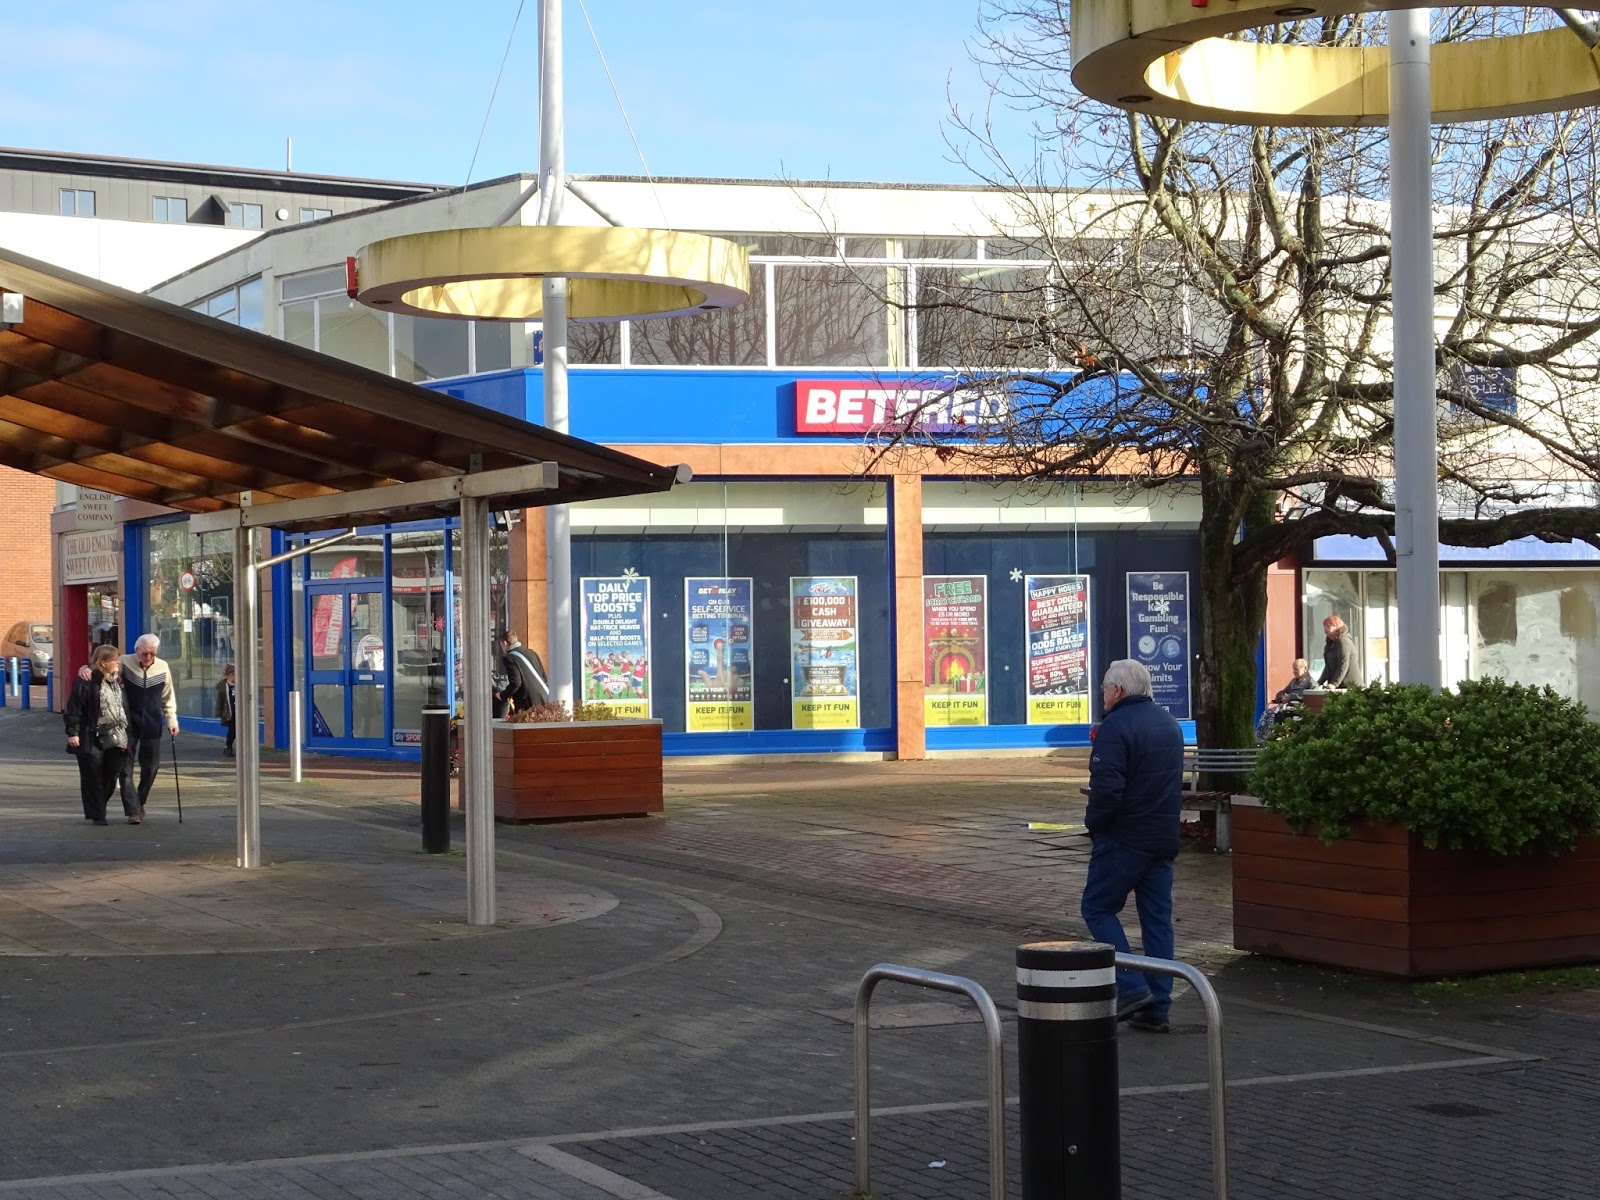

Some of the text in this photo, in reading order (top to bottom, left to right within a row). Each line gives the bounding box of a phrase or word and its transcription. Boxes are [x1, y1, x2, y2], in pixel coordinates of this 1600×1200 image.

[1469, 373, 1498, 383] SHP
[805, 388, 1009, 424] BETFRED
[77, 513, 114, 521] COMPANY
[66, 533, 117, 556] THE OLD ENGLIS
[66, 553, 117, 576] SWEET COMPAN
[598, 583, 630, 593] DAILY
[934, 580, 972, 596] FREE
[1152, 581, 1164, 590] Be
[1033, 584, 1081, 598] HAPPY HOURS
[587, 593, 642, 603] TOP PRICE
[803, 596, 845, 606] £100,000
[1036, 594, 1079, 609] BEST ODDS
[1132, 591, 1185, 603] Responsible
[593, 602, 636, 612] BOOSTS
[691, 605, 746, 613] SELF-SERVICE
[812, 607, 837, 616] CASH
[1031, 601, 1083, 617] GUARANTEED
[801, 618, 848, 628] GIVEAWAY
[1138, 613, 1179, 625] Gambling
[1149, 624, 1169, 633] Fun!
[1043, 628, 1072, 640] 6 BEST
[1031, 640, 1056, 650] ODDS
[1031, 657, 1053, 667] SUPER
[1162, 662, 1183, 671] Your
[1150, 673, 1173, 682] imits
[624, 706, 641, 714] FUN
[695, 706, 716, 714] KEEP
[718, 706, 725, 714] IT
[833, 703, 850, 711] FUN
[931, 701, 951, 709] KEEP
[405, 733, 421, 742] SPOR
